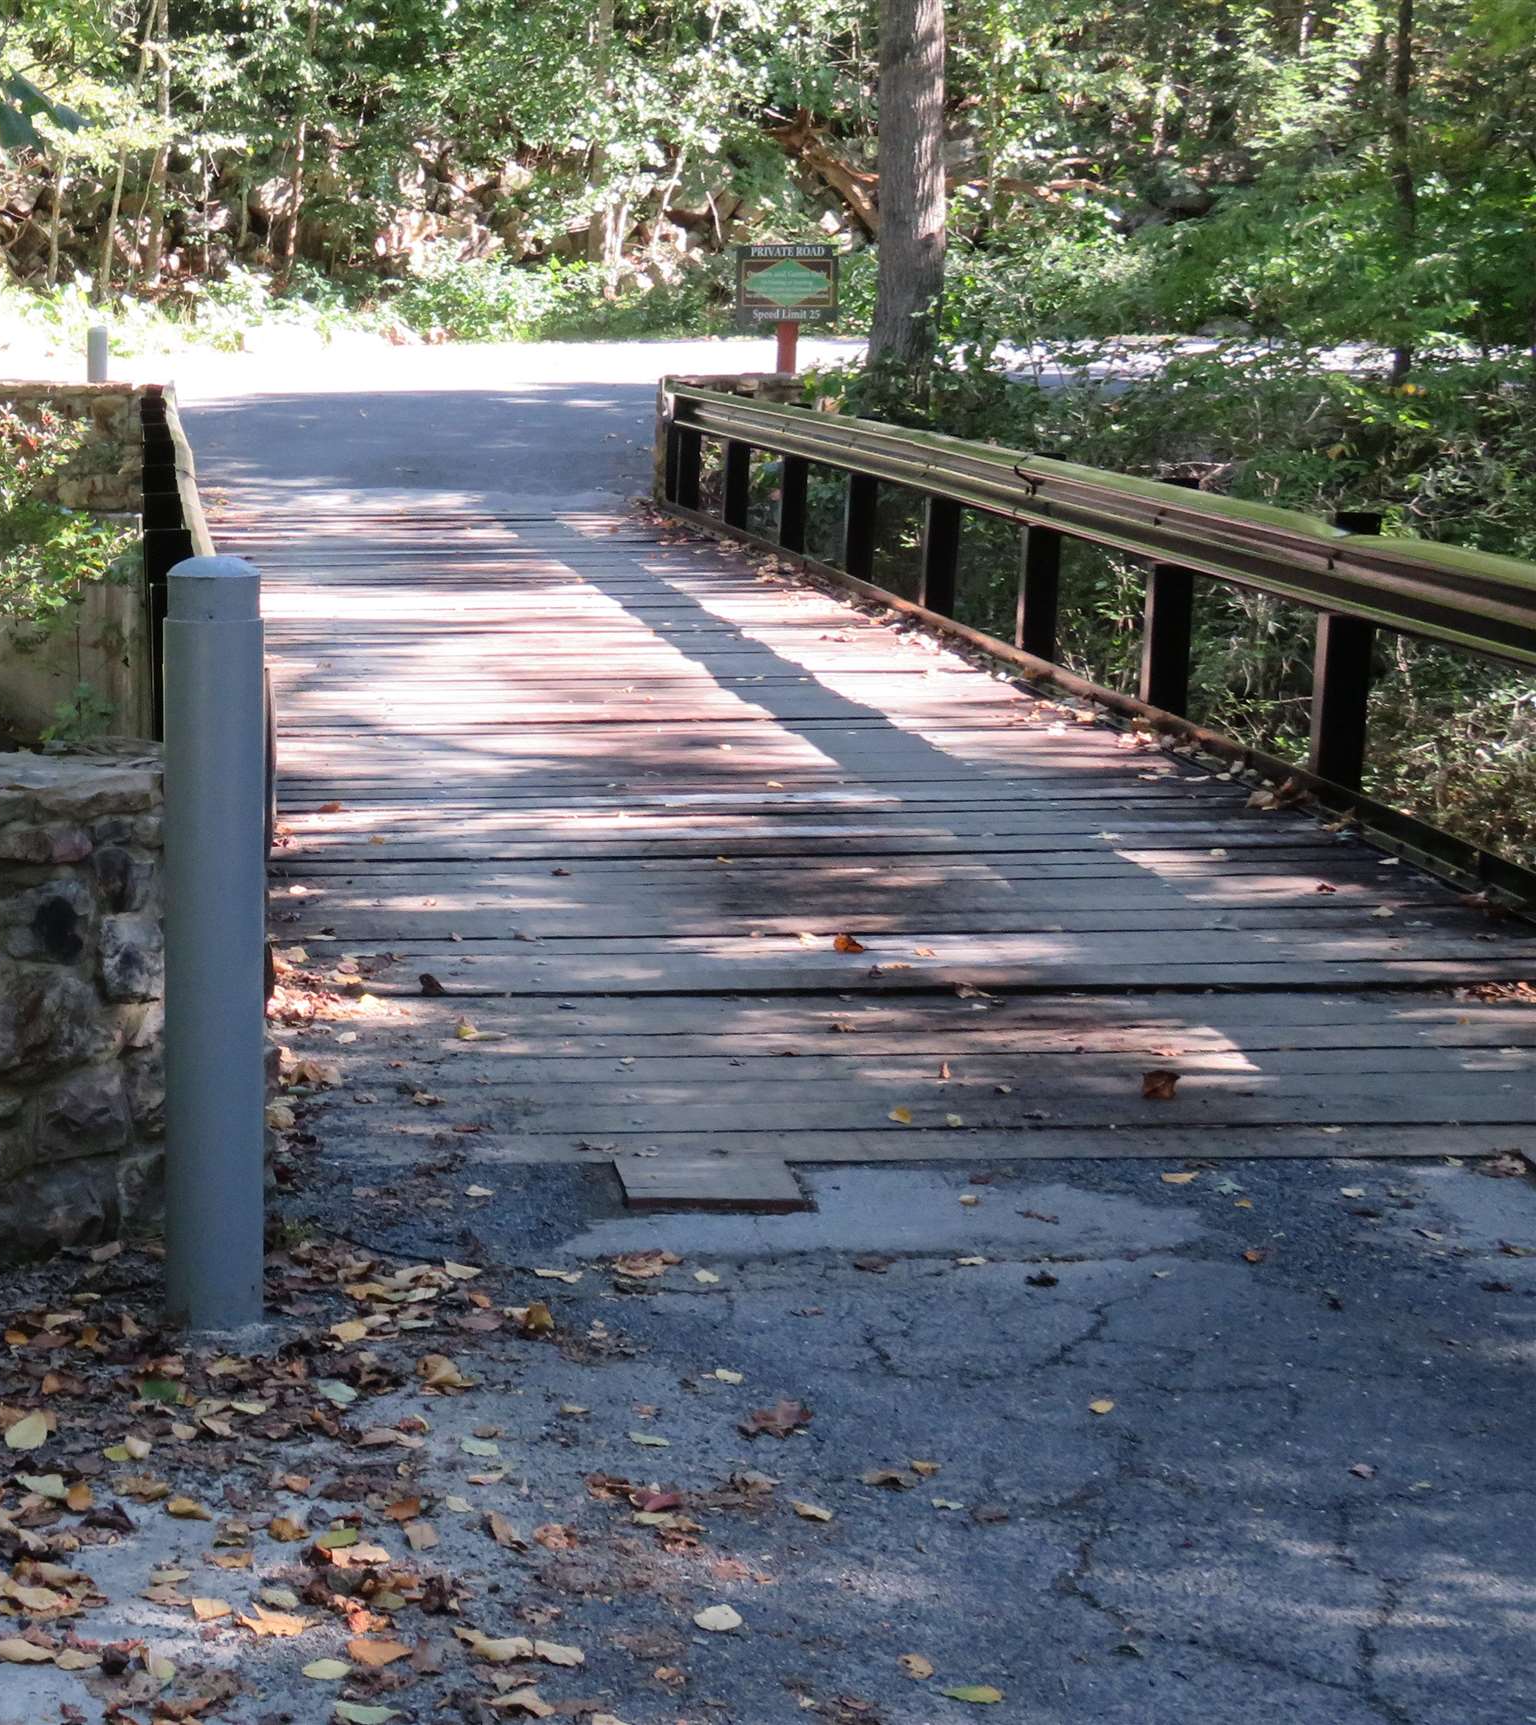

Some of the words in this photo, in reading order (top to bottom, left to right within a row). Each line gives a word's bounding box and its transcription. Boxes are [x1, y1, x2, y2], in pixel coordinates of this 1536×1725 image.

[751, 246, 794, 257] PRIVATE
[796, 246, 824, 257] ROAD
[752, 309, 779, 321] Speed
[782, 309, 807, 319] Limit
[809, 309, 821, 319] 25
